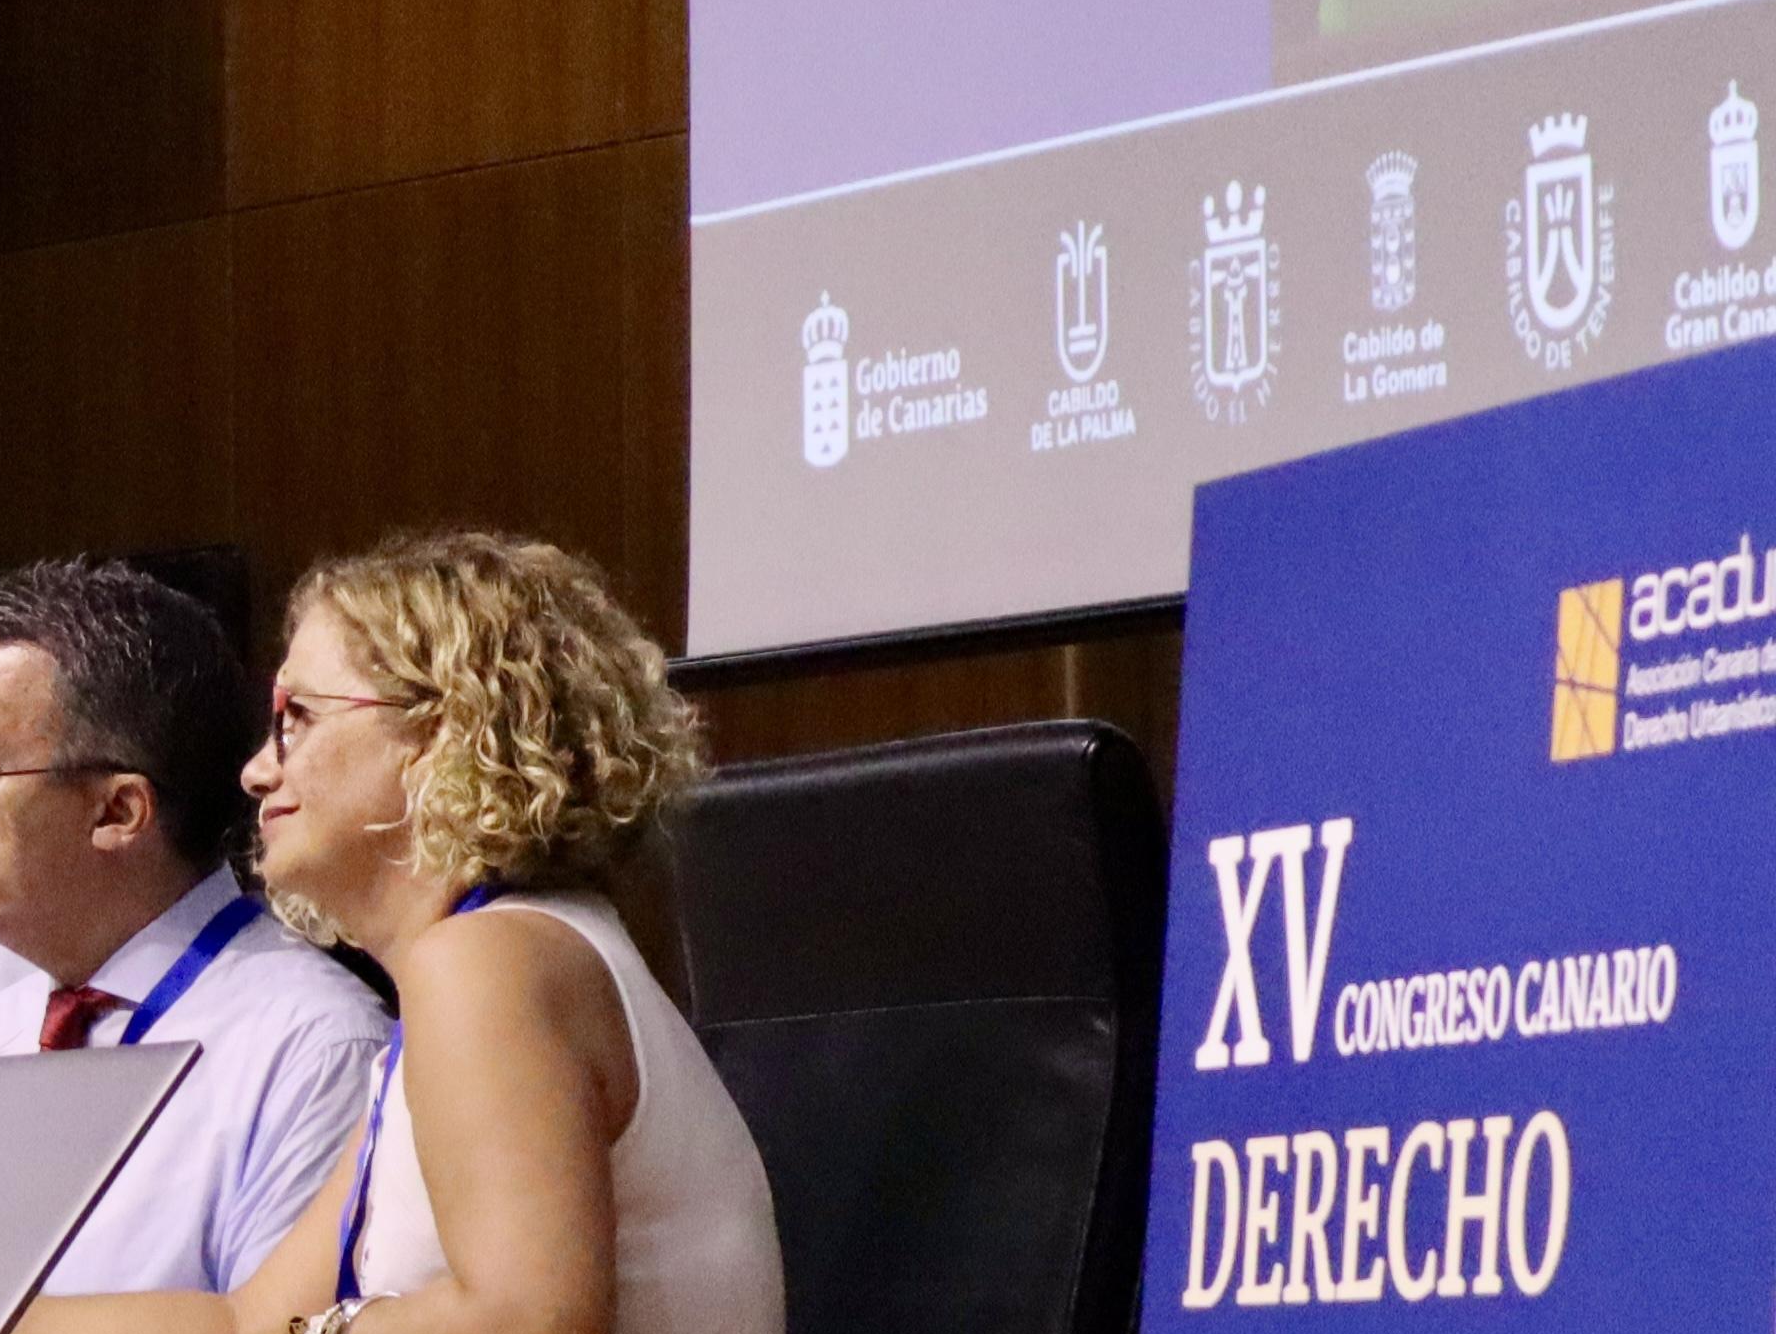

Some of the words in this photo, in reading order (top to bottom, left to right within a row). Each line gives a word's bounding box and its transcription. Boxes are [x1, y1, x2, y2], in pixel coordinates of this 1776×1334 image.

[1674, 262, 1760, 309] Cabildo
[1344, 324, 1415, 363] Cabildo
[1420, 317, 1444, 351] de
[1665, 313, 1719, 349] Gran
[856, 347, 961, 395] Gobierno
[1344, 371, 1368, 402] La
[1372, 361, 1447, 398] Gomera
[856, 399, 883, 439] de
[889, 383, 988, 434] Canarias
[1048, 380, 1120, 417] CABILDO
[1031, 422, 1053, 451] DE
[1057, 418, 1078, 445] LA
[1081, 408, 1137, 441] PALMA
[1195, 817, 1354, 1071] XV
[1334, 965, 1511, 1056] CONGRESO
[1515, 943, 1677, 1037] CANARIO
[1182, 1110, 1571, 1309] DERECHO
